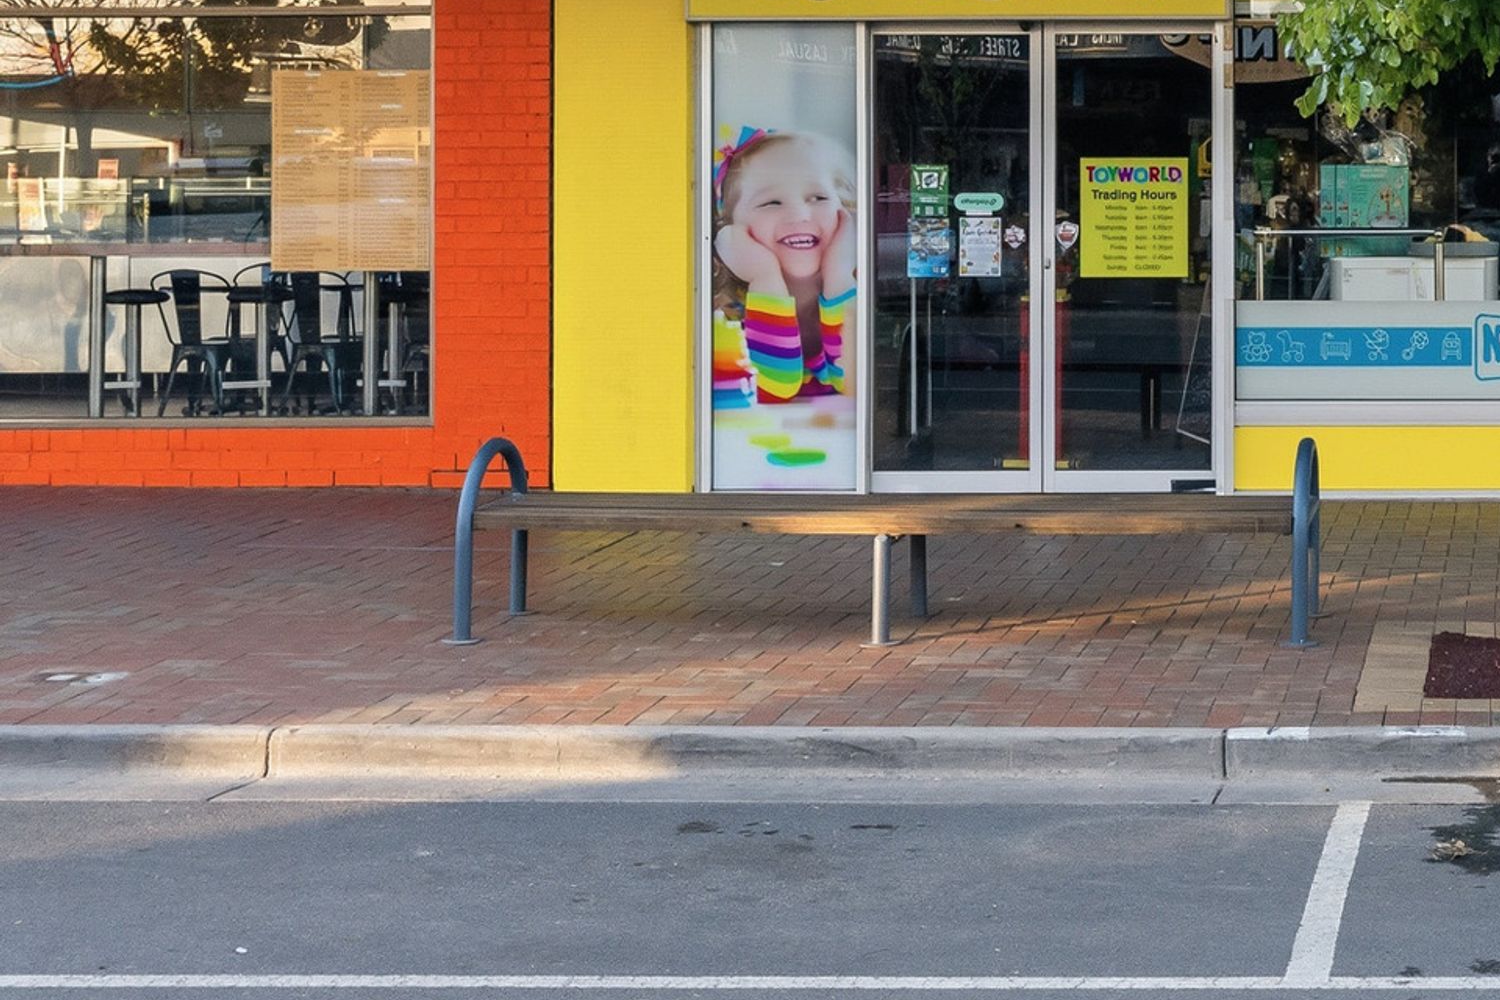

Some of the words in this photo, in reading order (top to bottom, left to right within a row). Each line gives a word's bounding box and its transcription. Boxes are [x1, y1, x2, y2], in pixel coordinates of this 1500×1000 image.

[1086, 165, 1182, 184] TOYWORLD
[1091, 189, 1137, 202] Trading
[1140, 189, 1177, 200] Hours
